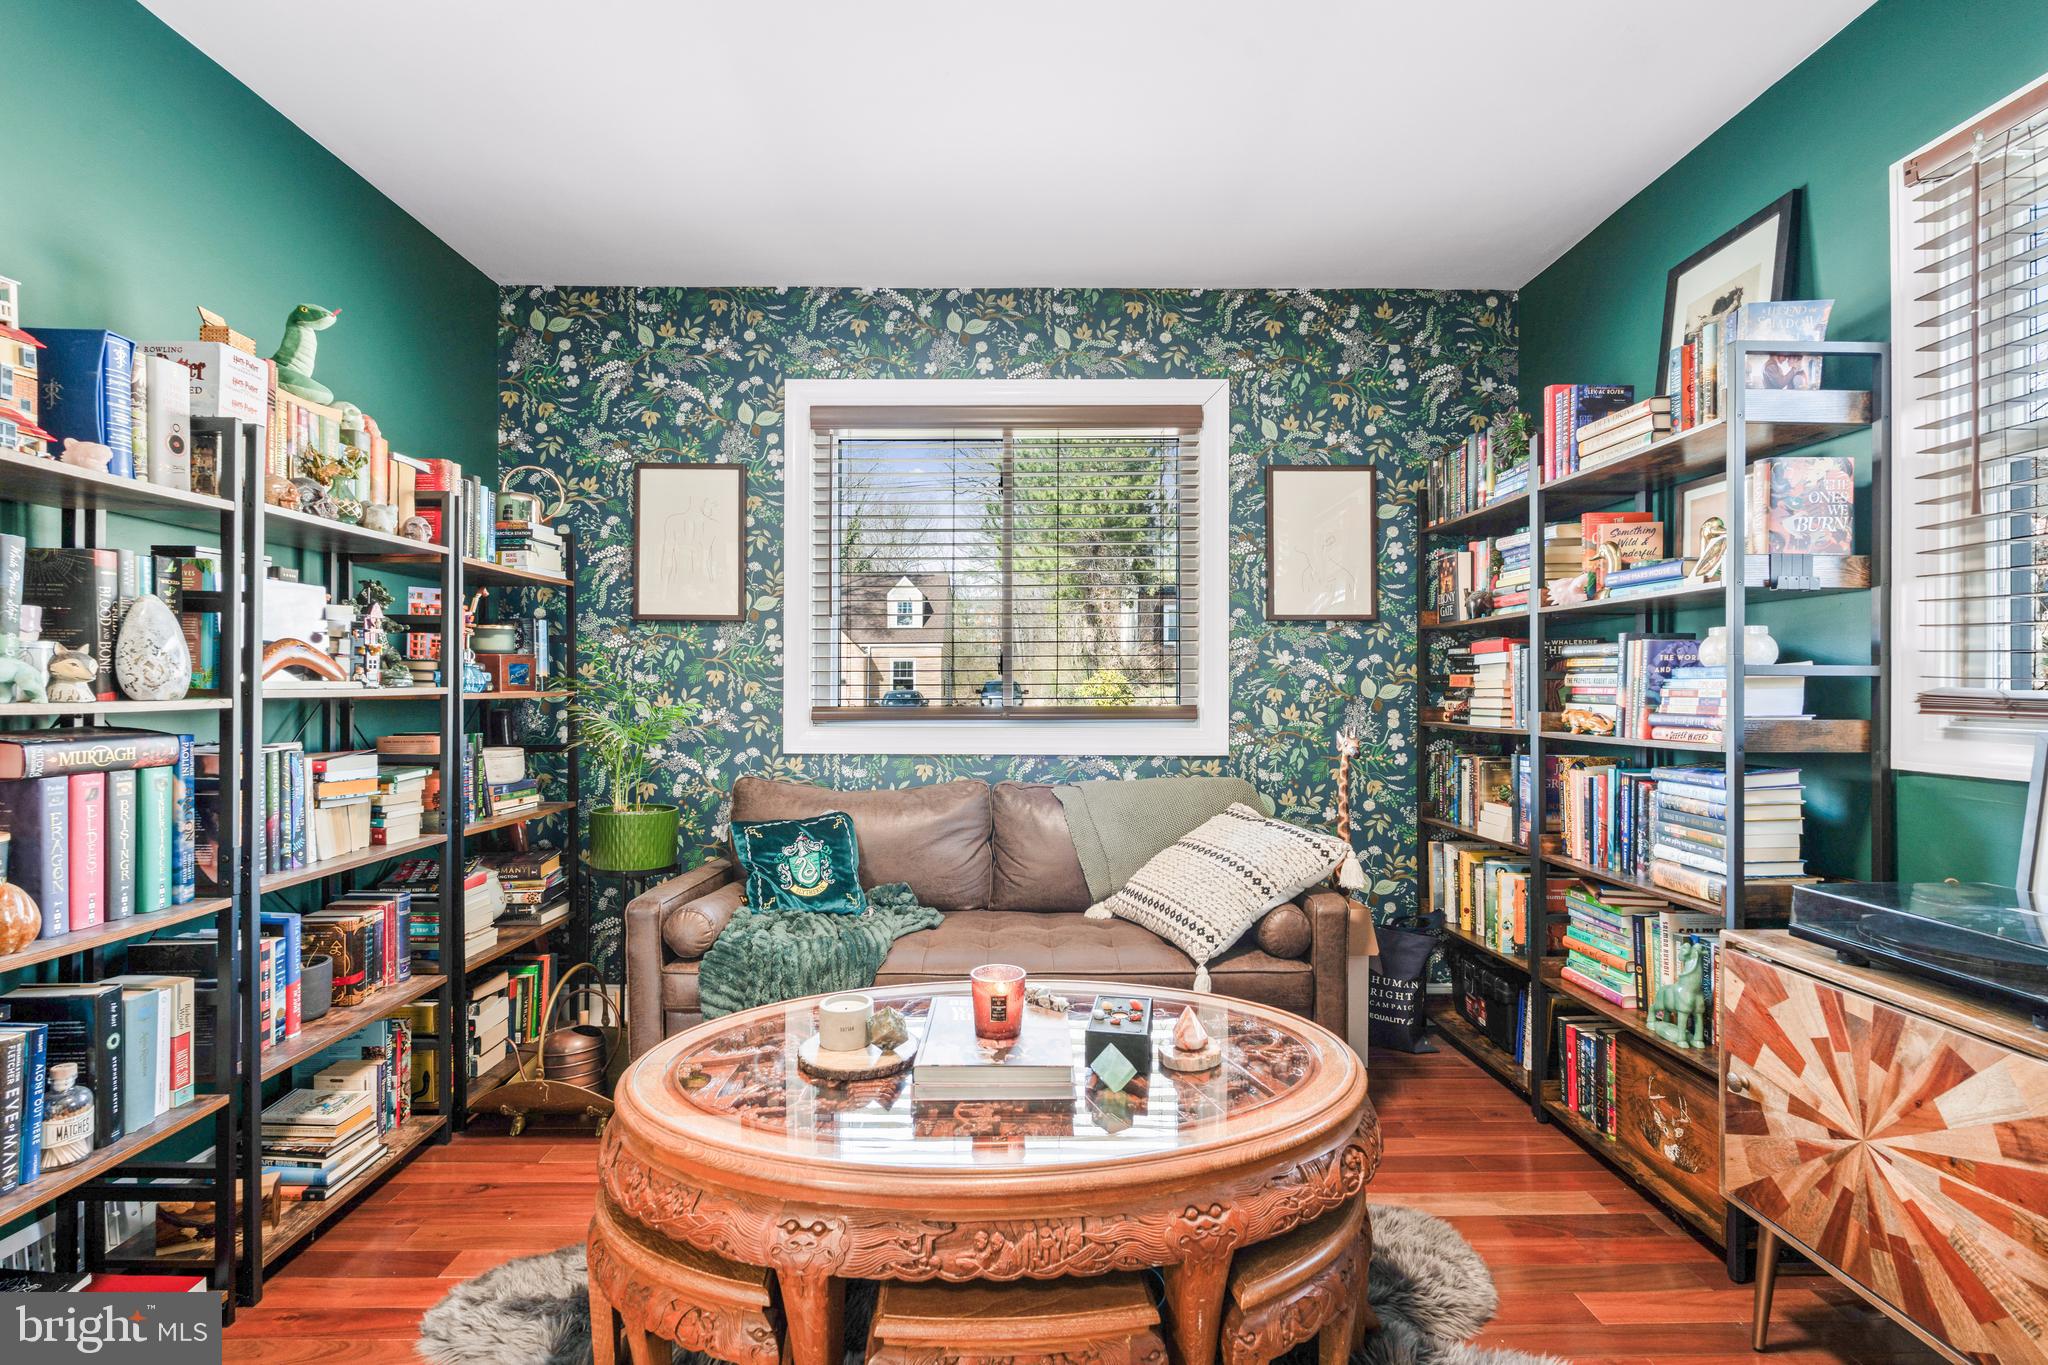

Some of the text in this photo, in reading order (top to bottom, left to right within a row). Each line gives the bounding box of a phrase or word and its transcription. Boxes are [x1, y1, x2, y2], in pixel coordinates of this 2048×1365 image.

[1824, 479, 1848, 491] THE
[1809, 491, 1848, 504] ONES
[1828, 504, 1848, 516] WE
[1610, 525, 1657, 538] Something
[1795, 516, 1852, 532] BURN
[1617, 537, 1649, 548] Wild &
[1621, 546, 1658, 560] nderful
[1619, 566, 1671, 582] THE MARS HOUSE
[98, 586, 112, 627] BLOOD
[1438, 590, 1456, 605] EBONY
[1439, 604, 1454, 617] GATE
[98, 641, 112, 674] BONE
[35, 745, 44, 777] PAOLINI
[58, 745, 137, 767] MURTAGH
[181, 742, 190, 777] PAOLINI
[271, 754, 279, 820] MEXICAN GOTHIC
[86, 804, 97, 880] ELDEST
[118, 799, 130, 880] BRISINGR
[49, 812, 65, 894] ERAGON
[500, 866, 528, 874] MANY
[795, 884, 826, 896] SLYTHERIN
[1371, 975, 1420, 989] HUMAN
[1370, 987, 1414, 1001] RIGHT
[183, 1003, 191, 1028] Richard
[1369, 1000, 1415, 1012] CAMPAIG
[1369, 1012, 1406, 1025] EQUALITY
[7, 1044, 17, 1086] FLETCHER
[176, 1048, 188, 1086] NATIVE SON
[34, 1064, 45, 1096] ALONE
[4, 1088, 20, 1125] EVE
[33, 1097, 43, 1118] OUT
[32, 1119, 42, 1146] HERE
[56, 1117, 90, 1142] MATCHES
[2, 1134, 19, 1180] MAN
